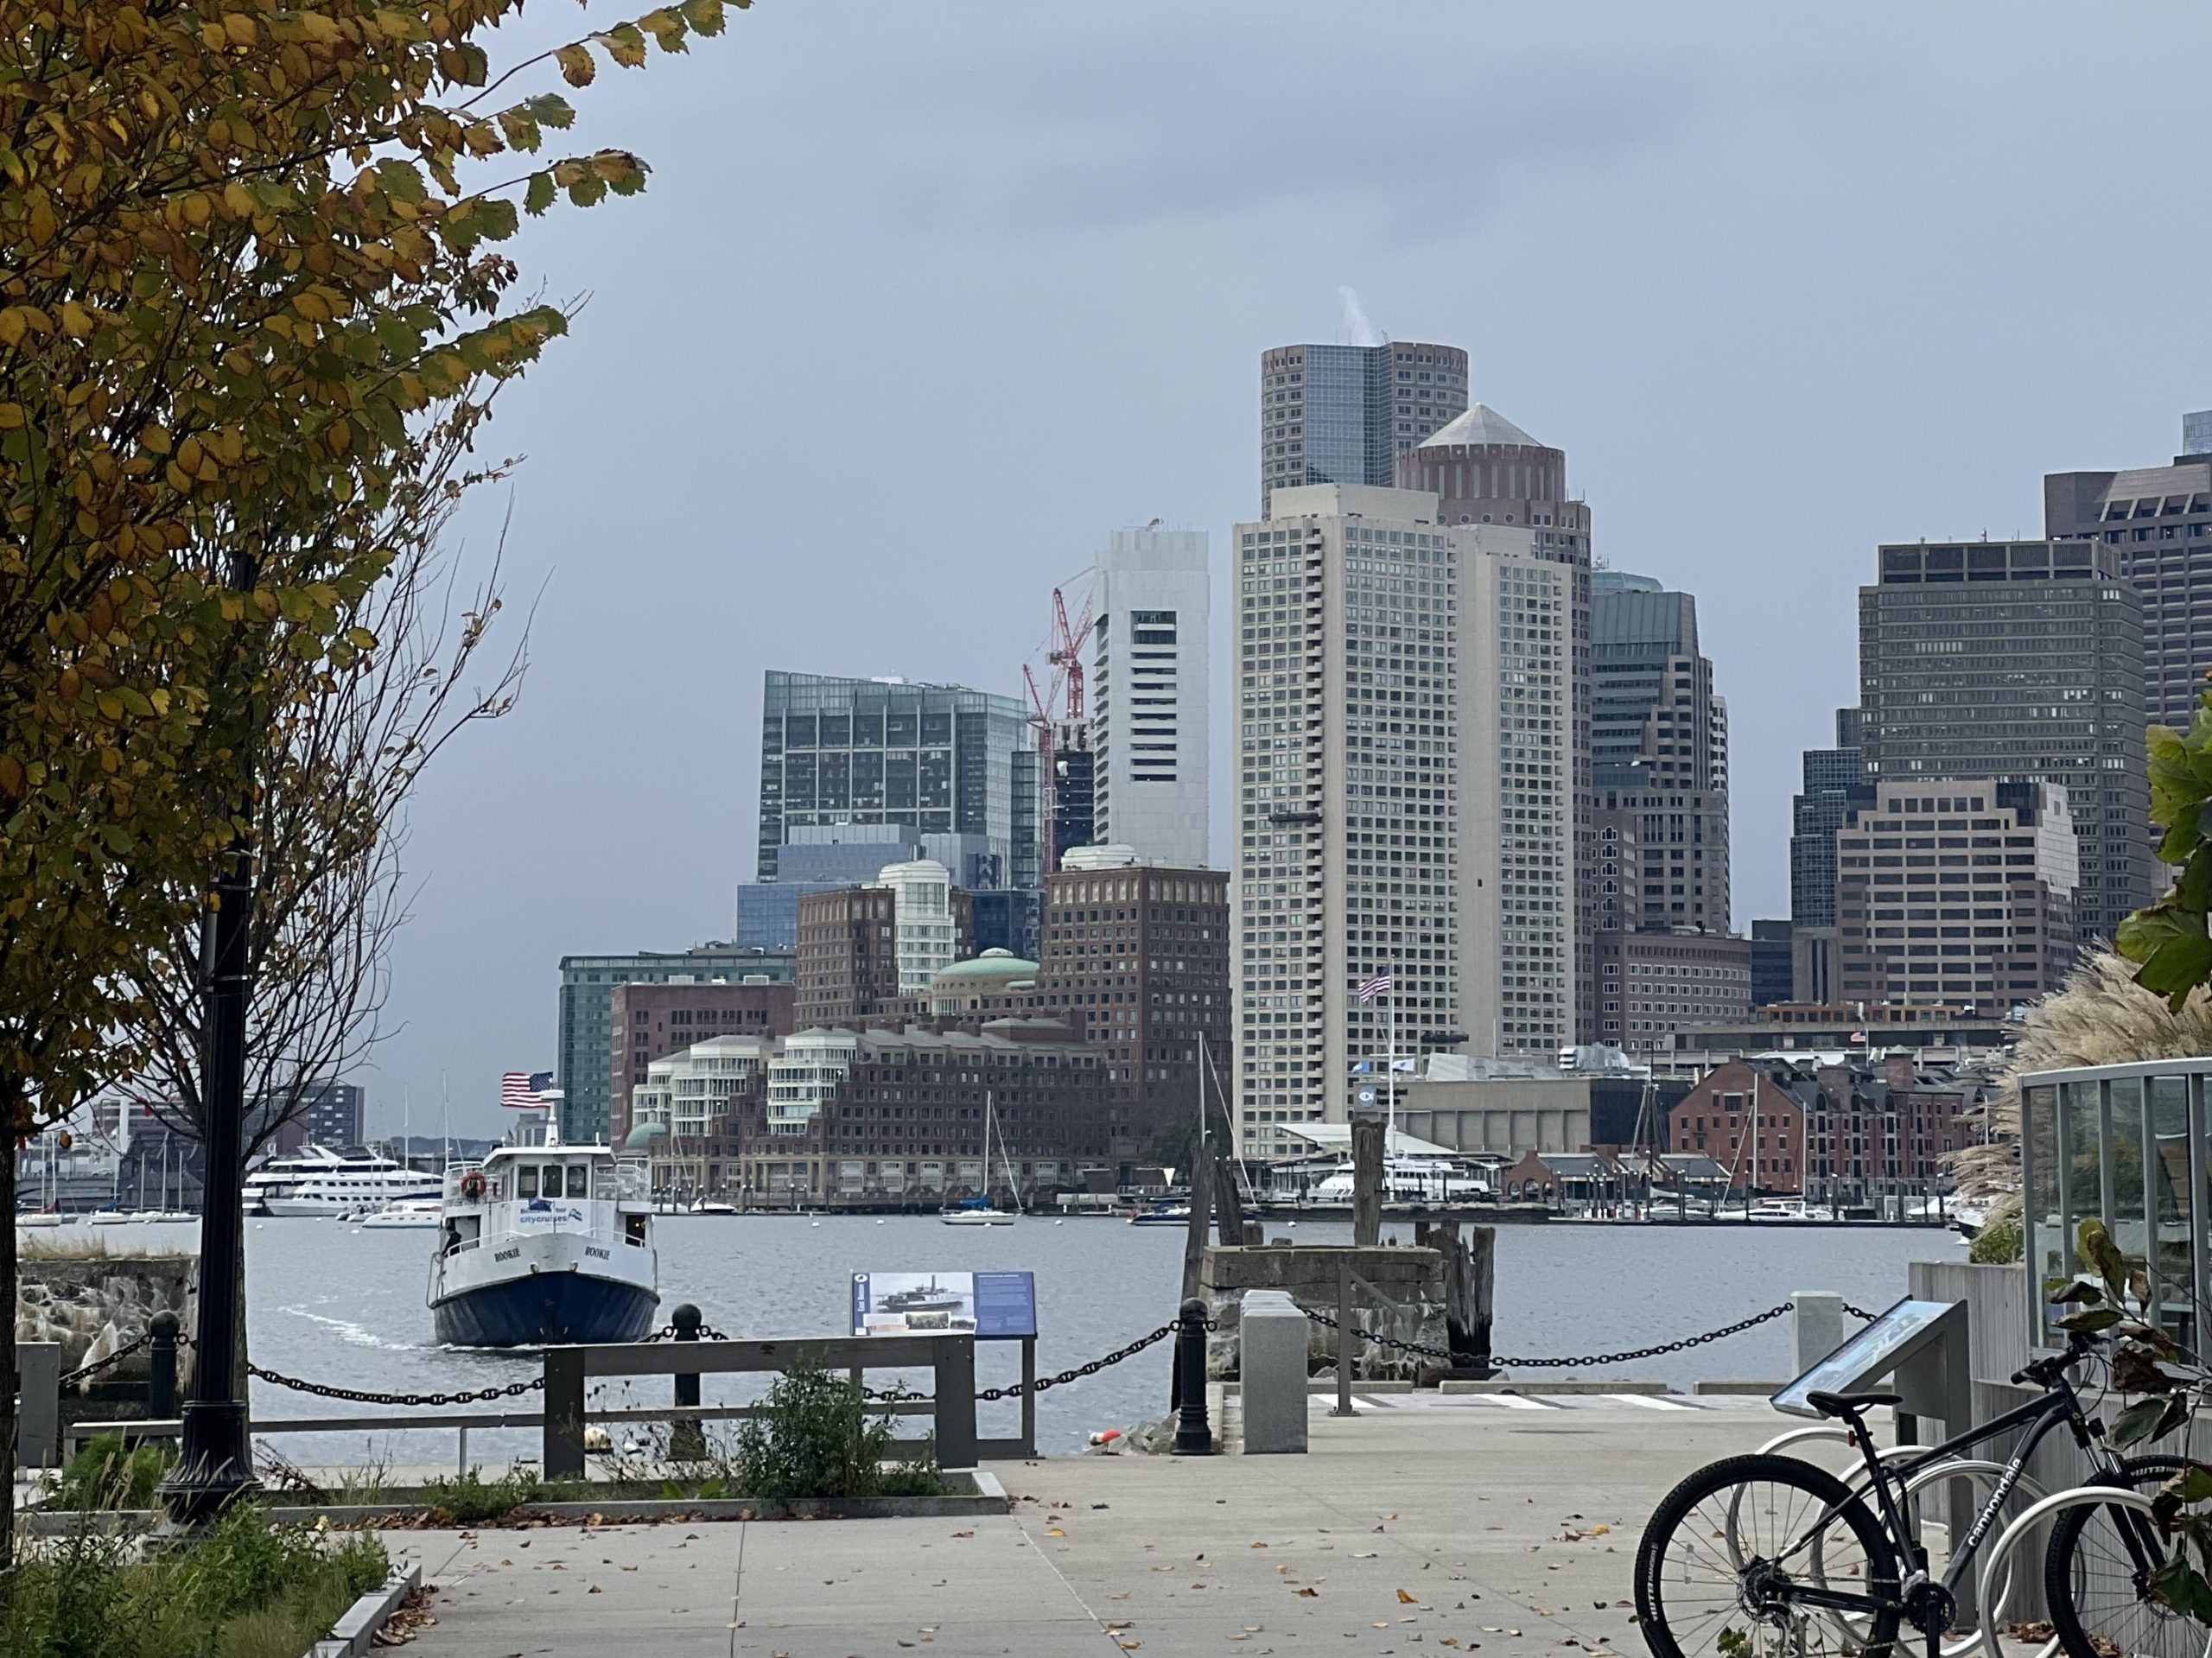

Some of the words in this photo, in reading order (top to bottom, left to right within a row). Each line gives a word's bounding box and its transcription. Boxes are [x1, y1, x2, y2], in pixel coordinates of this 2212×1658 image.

[494, 1247, 522, 1262] ROOKIE
[584, 1246, 611, 1261] ROOKIE
[1968, 1458, 2024, 1547] cannondale
